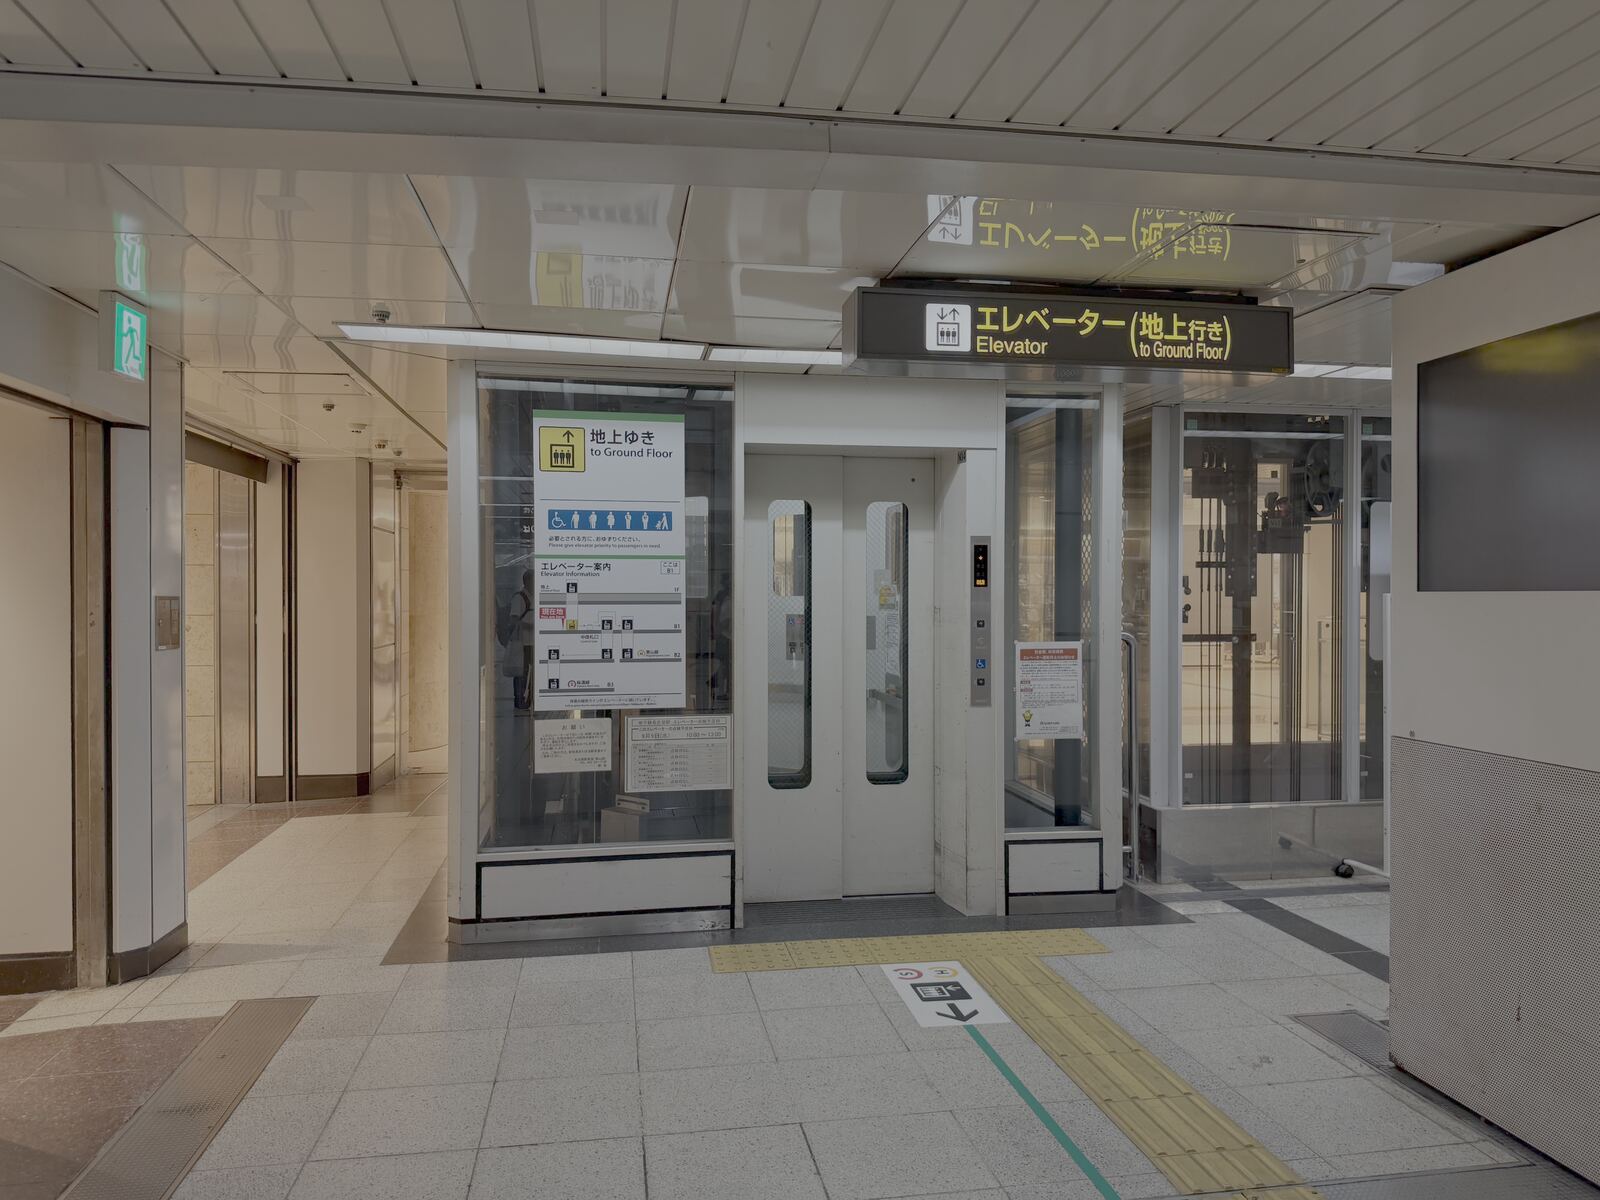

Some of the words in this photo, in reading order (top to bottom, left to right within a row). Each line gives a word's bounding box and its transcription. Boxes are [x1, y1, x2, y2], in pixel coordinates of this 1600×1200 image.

[976, 305, 1126, 337] エレベーター
[976, 336, 1048, 355] Elevator
[1139, 343, 1152, 357] to
[1153, 342, 1194, 359] Ground
[1195, 344, 1224, 360] Floor
[590, 429, 655, 446] 地上ゆき
[590, 448, 602, 457] to
[603, 447, 644, 458] Ground
[646, 448, 673, 459] Floor
[541, 562, 611, 572] エレベーター案内
[541, 608, 564, 616] 現在地
